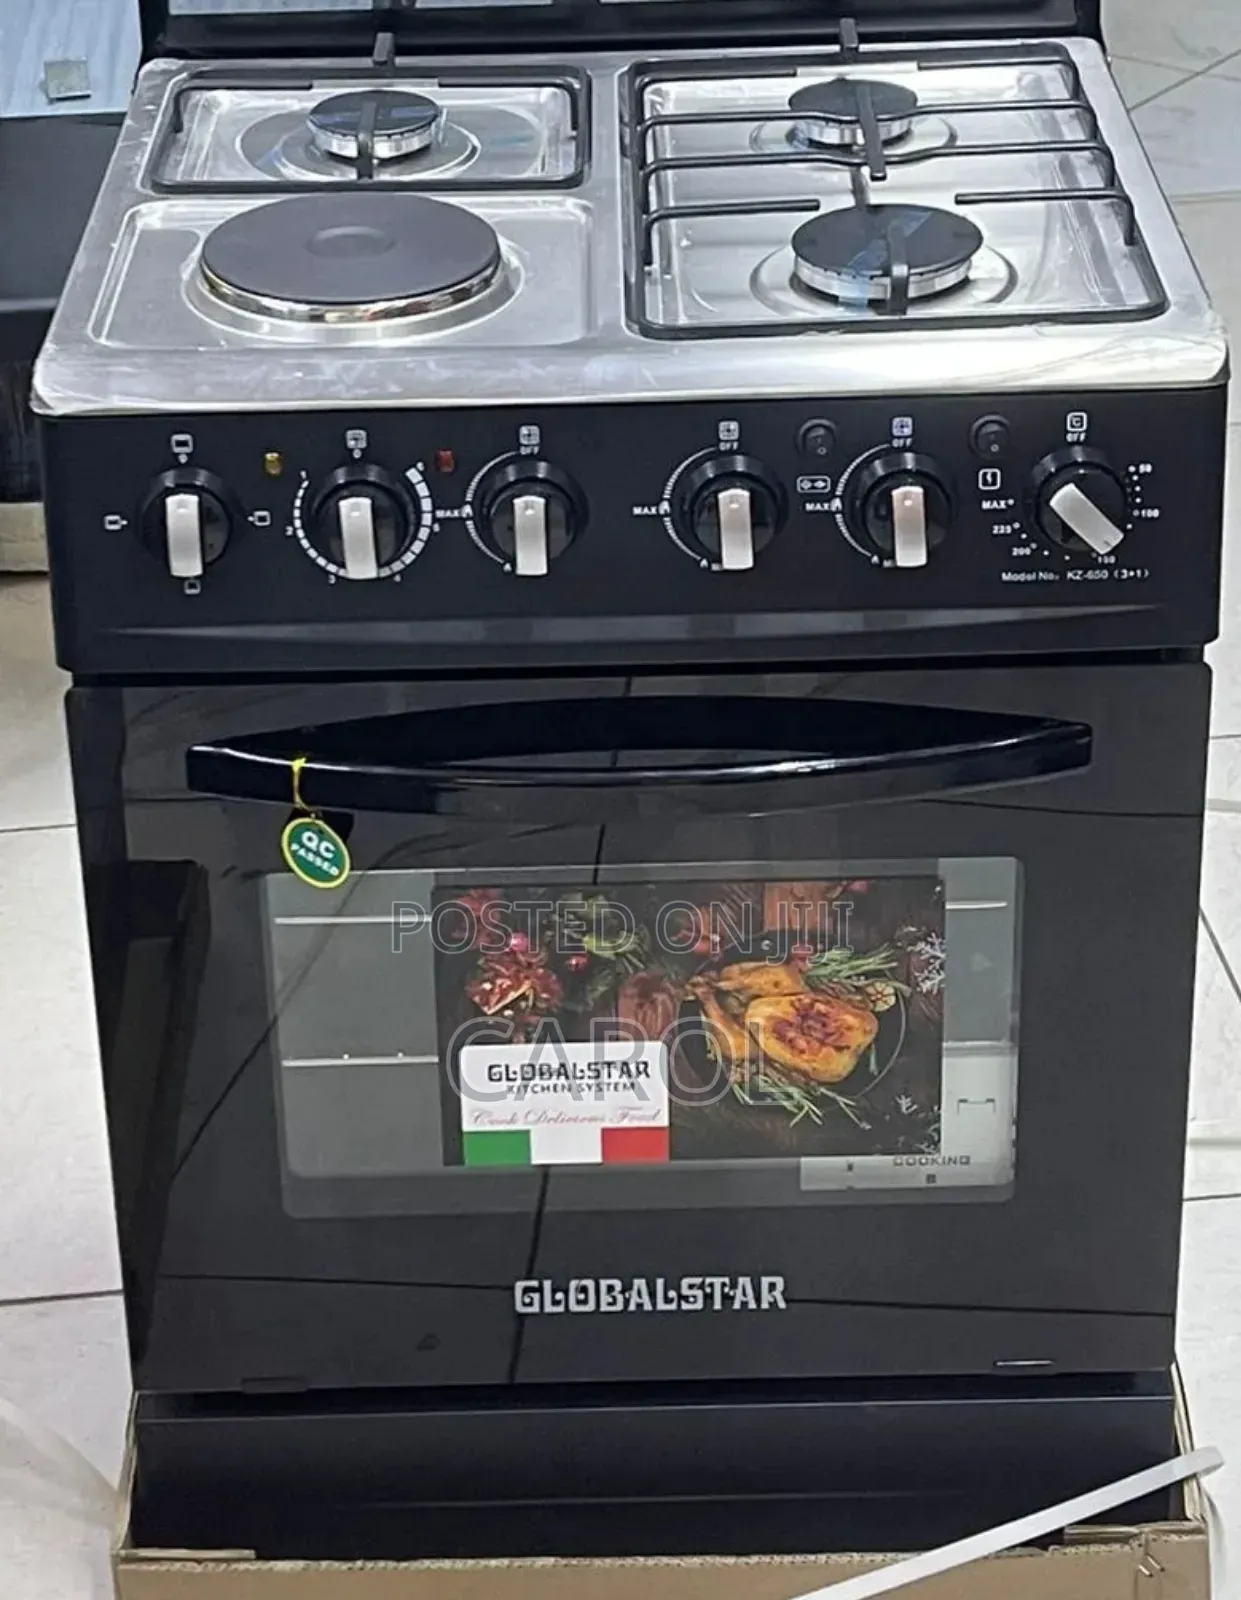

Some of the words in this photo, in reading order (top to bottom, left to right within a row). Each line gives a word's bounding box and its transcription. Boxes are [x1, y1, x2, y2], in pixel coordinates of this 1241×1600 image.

[1066, 432, 1086, 442] OFF
[805, 503, 830, 512] MAX
[981, 500, 1007, 510] MAX
[435, 509, 459, 519] MAX
[632, 506, 657, 516] MAX
[1141, 508, 1160, 519] 100
[1011, 547, 1031, 556] 200
[1001, 571, 1037, 582] Model
[301, 831, 336, 859] QC
[290, 842, 340, 876] PASSED
[487, 1060, 651, 1083] GLOBALSTAR
[507, 1082, 571, 1095] KITCHEN
[576, 1081, 636, 1093] SYSTEM
[514, 1276, 787, 1313] GLOBALSTAR
